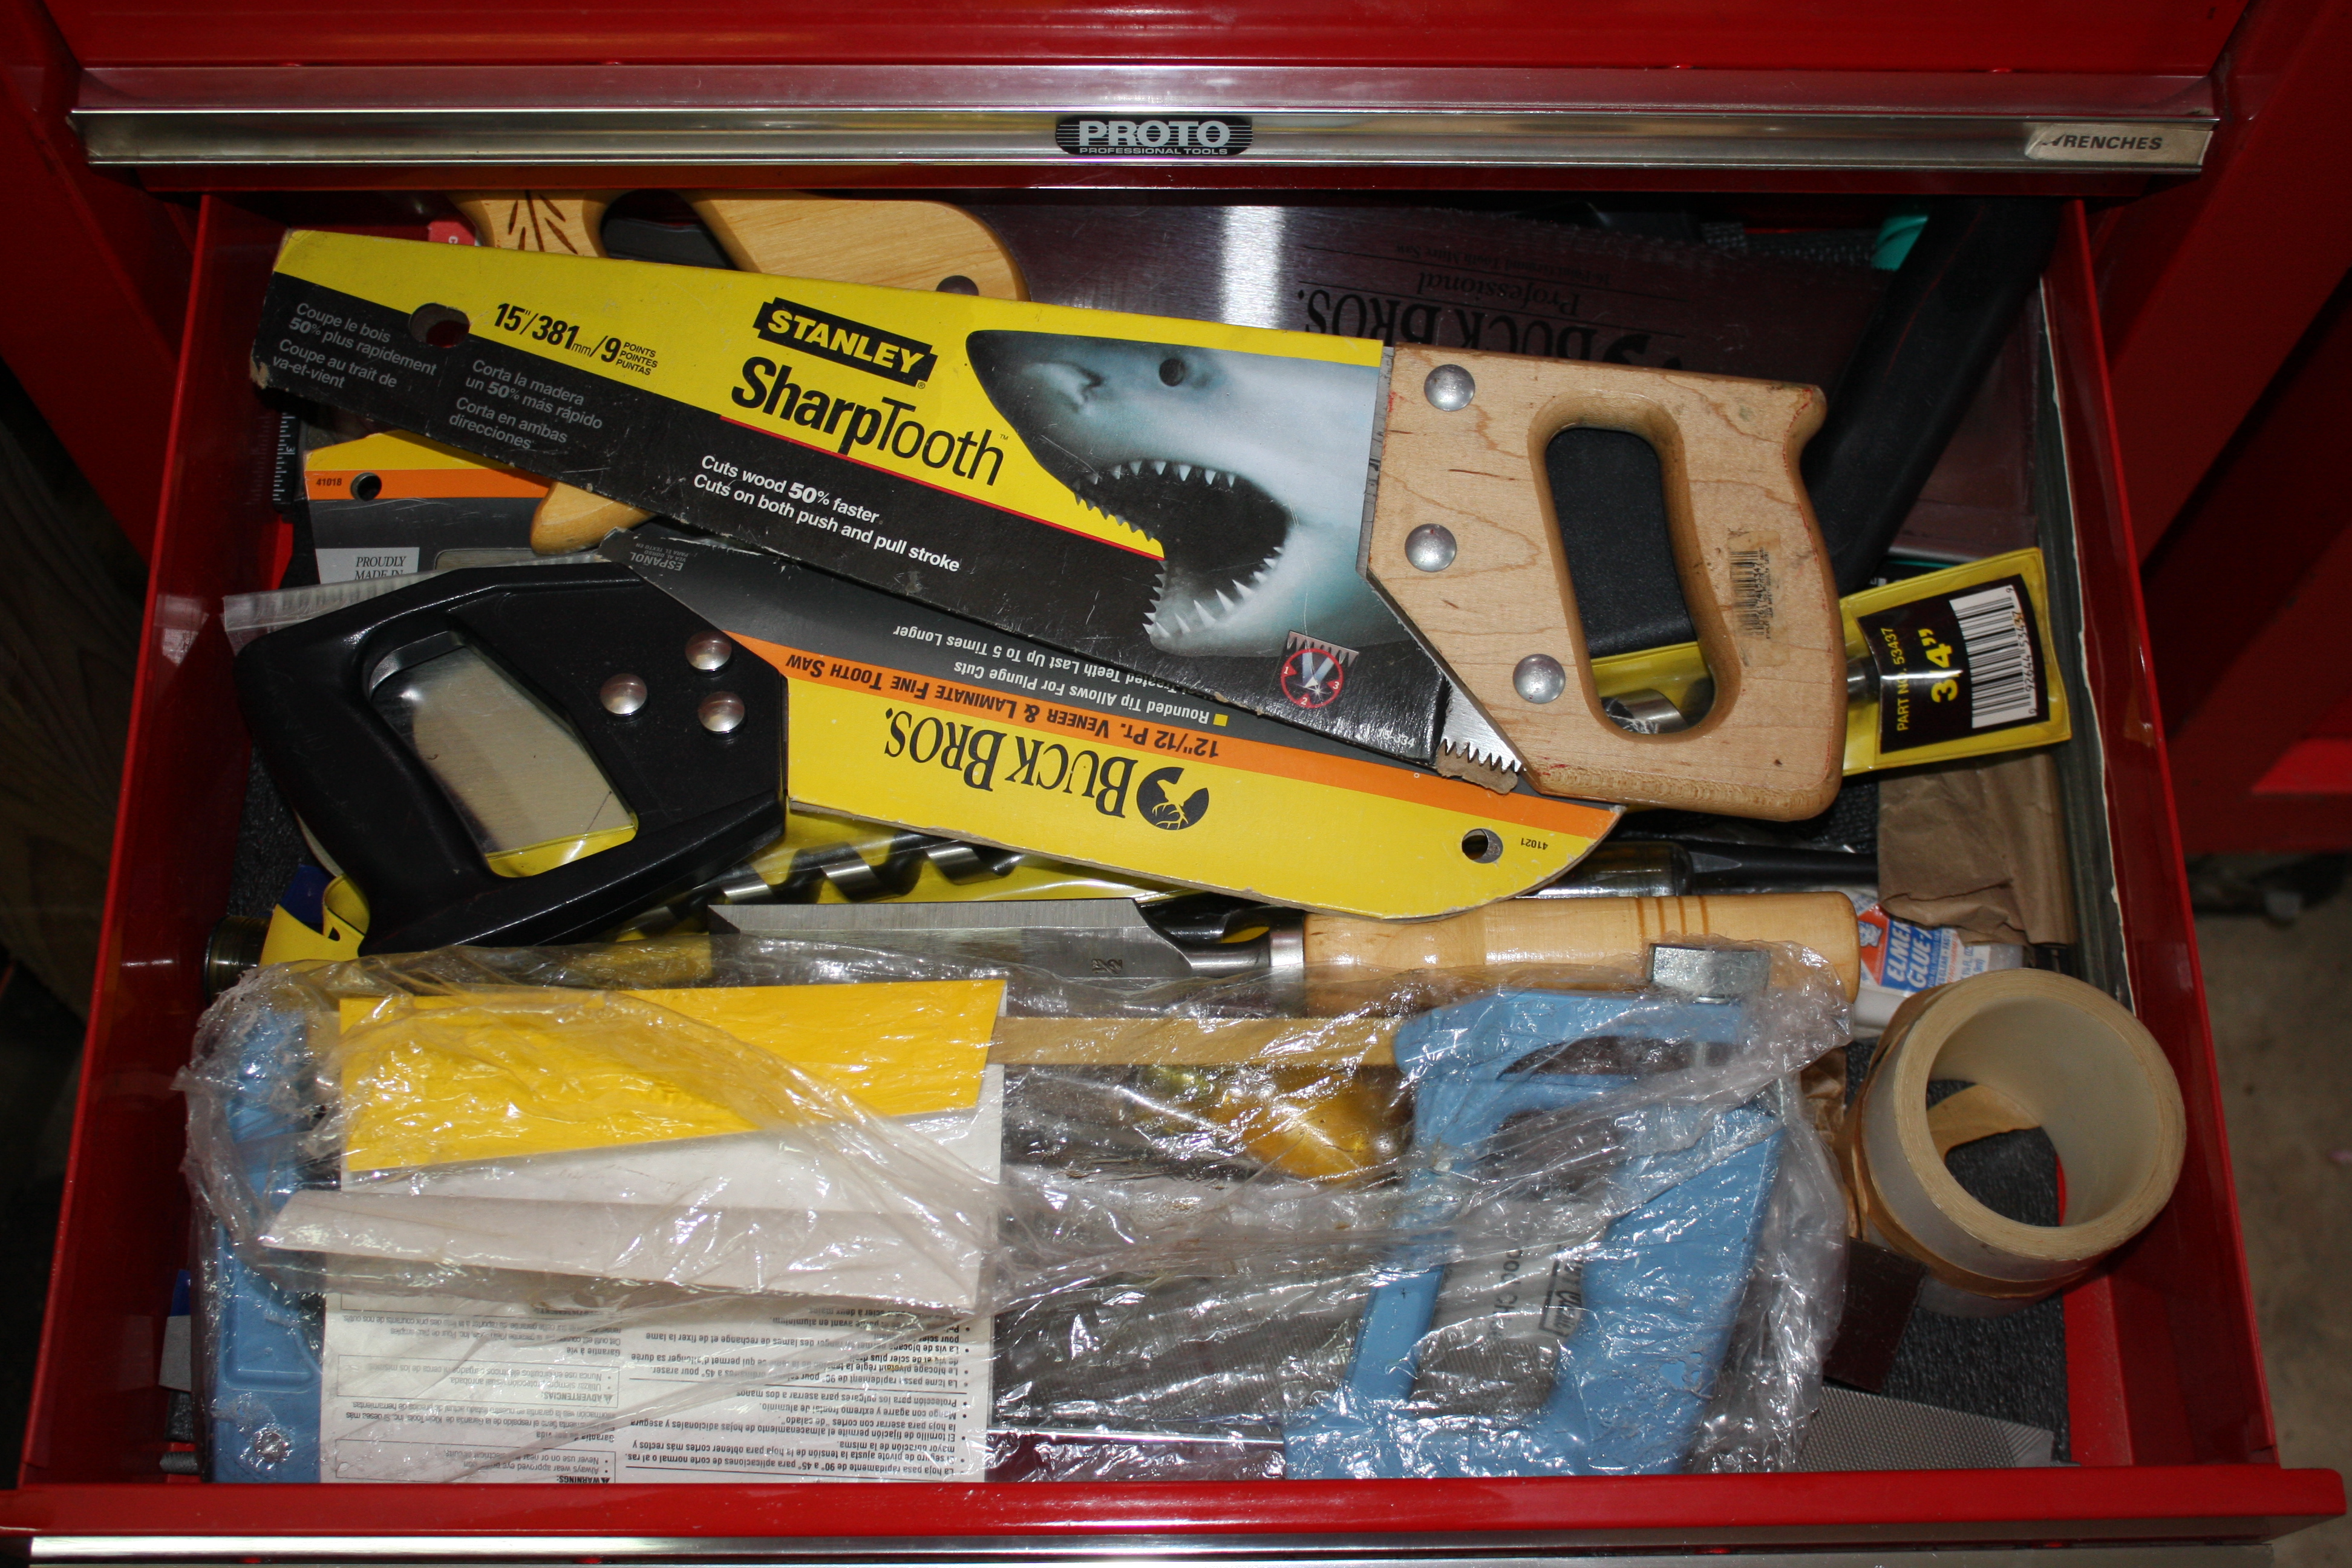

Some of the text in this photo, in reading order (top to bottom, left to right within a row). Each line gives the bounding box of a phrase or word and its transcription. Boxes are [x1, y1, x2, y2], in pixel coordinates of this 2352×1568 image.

[1079, 120, 1230, 148] PROTO
[1417, 270, 1581, 318] Professional
[296, 302, 390, 342] Coupe le bois
[289, 316, 436, 375] 50% plus rapidement
[623, 341, 656, 358] POINTS
[768, 310, 924, 373] STANLEY
[279, 339, 397, 387] Coupe au trait de
[615, 358, 651, 375] PUNTAS
[619, 350, 658, 368] POINTES
[273, 356, 345, 388] va-et-vient
[472, 359, 584, 405] Corta la madera
[465, 377, 603, 428] un 50% más rápido
[456, 397, 567, 442] Corta en ambas
[731, 356, 1005, 486] SharpTooth
[449, 414, 531, 450] direcciones
[702, 455, 879, 523] Cuts wood 50% faster
[694, 474, 959, 571] Cuts on both push and pull stroke
[355, 556, 407, 567] PROUDLY
[629, 551, 684, 572] ESPAÑOL
[355, 570, 388, 580] MADE
[892, 626, 942, 646] Longer
[946, 636, 987, 655] Times
[992, 645, 1002, 658] 5
[1006, 648, 1021, 662] To
[1881, 627, 1905, 665] 53437
[1027, 650, 1045, 667] Up
[1049, 656, 1079, 673] Last
[1083, 663, 1120, 682] Teeth
[1284, 666, 1289, 675] 1
[2022, 655, 2035, 691] 92644
[953, 661, 1209, 724] Rounded Tip Allows For Plunge Cuts
[1333, 681, 1340, 690] 3
[1301, 697, 1308, 705] 2
[1024, 704, 1040, 723] &
[1897, 697, 1909, 731] PART
[884, 708, 1138, 818] BUCK BROS.
[1520, 837, 1548, 850] 41021
[832, 1419, 857, 1427] cortes
[837, 1426, 869, 1438] permite
[639, 1442, 664, 1450] rectos
[916, 1432, 945, 1441] tornillo
[947, 1433, 955, 1442] El
[659, 1454, 688, 1463] normal
[713, 1445, 743, 1454] obtener
[851, 1449, 874, 1460] ajusta
[836, 1463, 847, 1471] de
